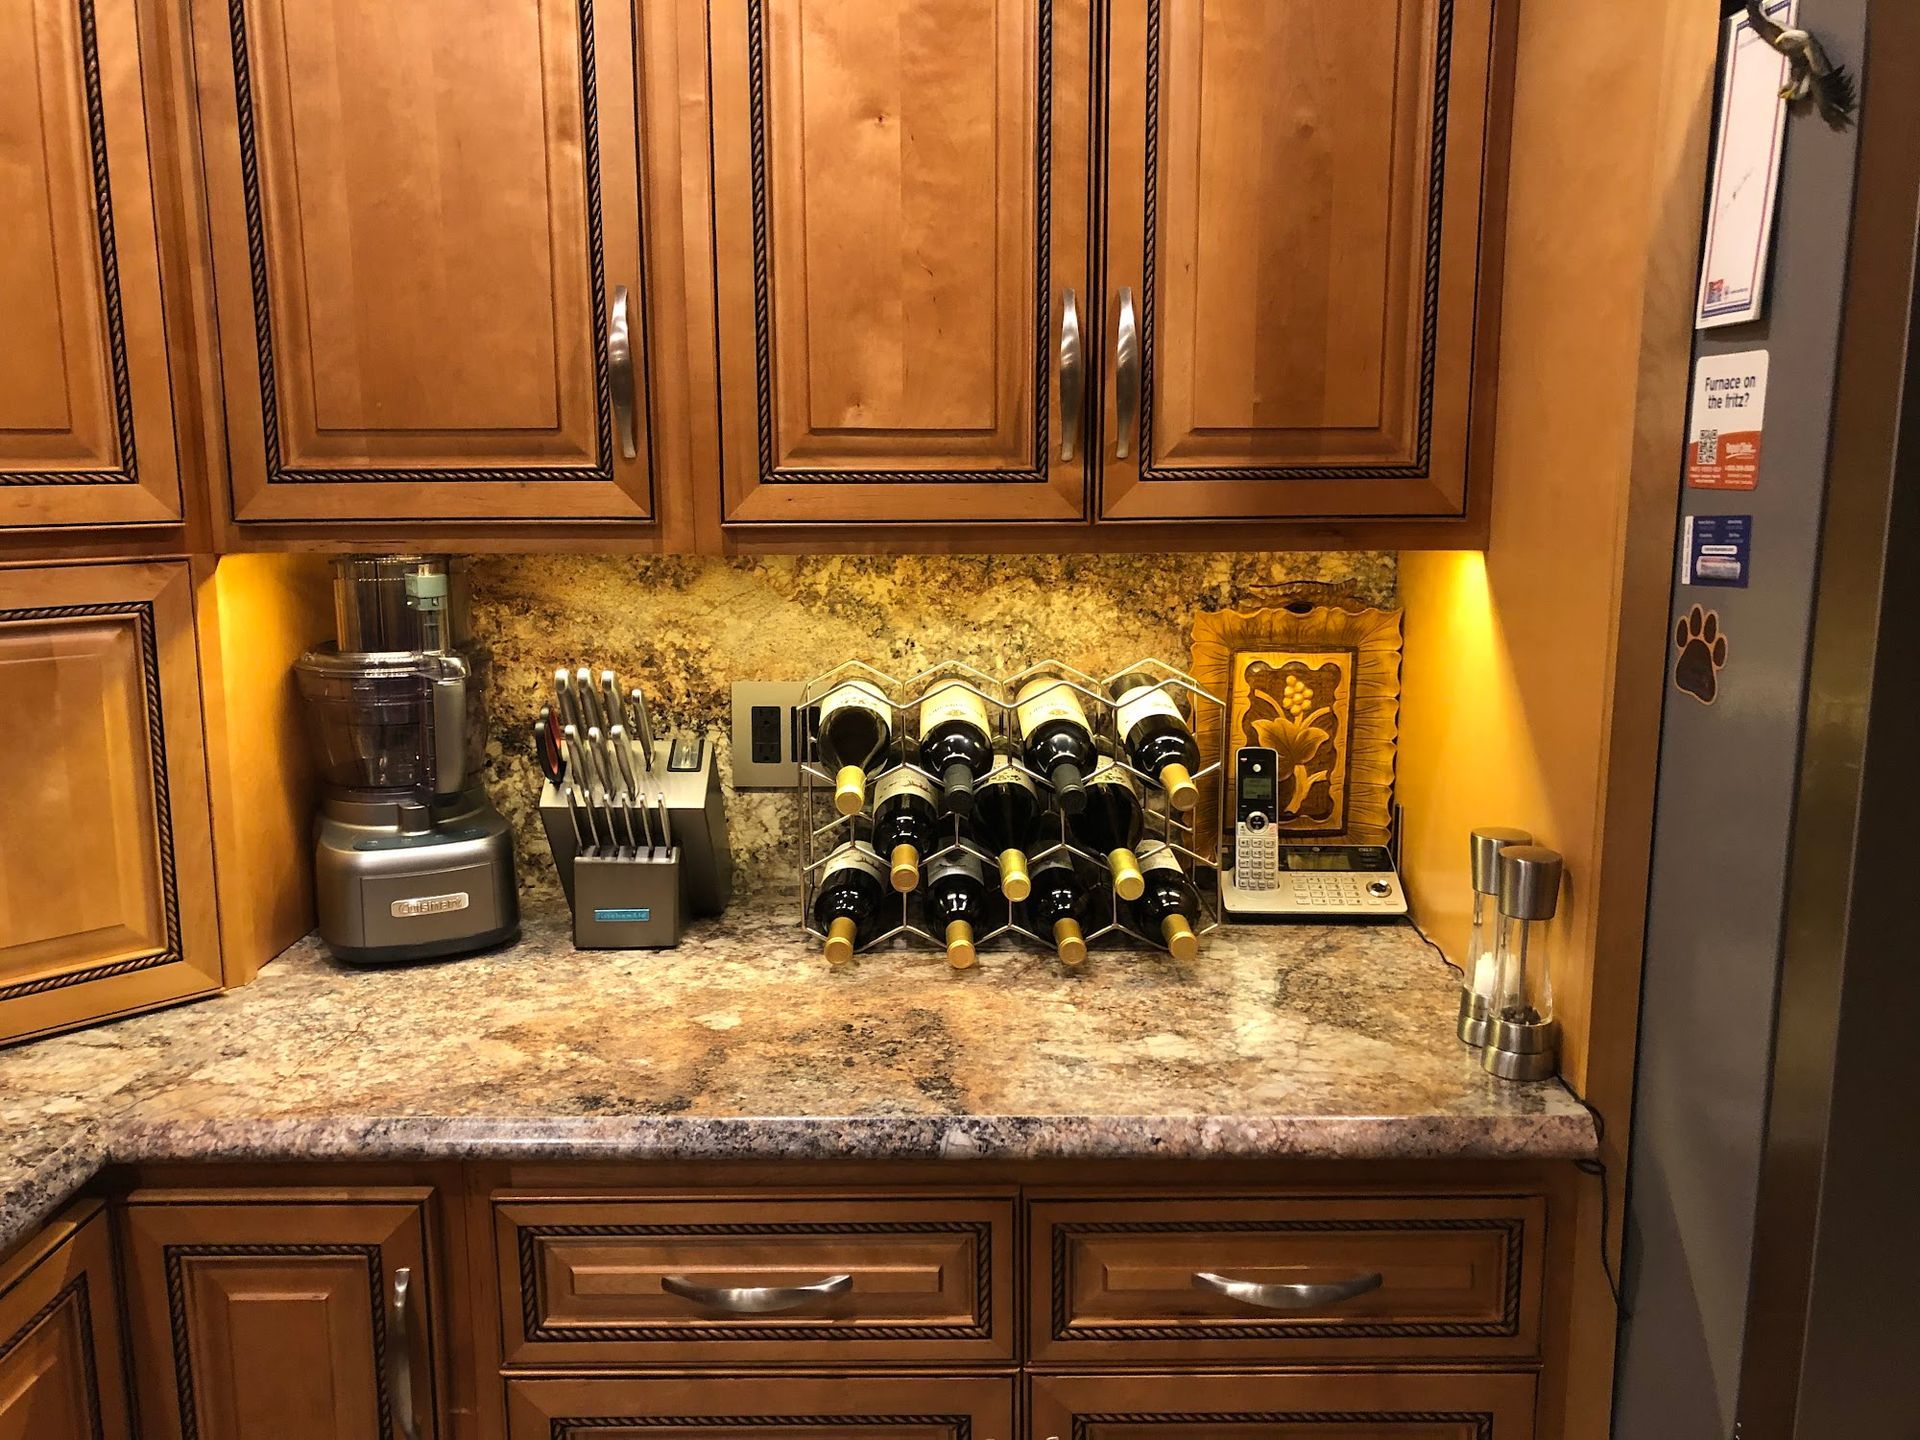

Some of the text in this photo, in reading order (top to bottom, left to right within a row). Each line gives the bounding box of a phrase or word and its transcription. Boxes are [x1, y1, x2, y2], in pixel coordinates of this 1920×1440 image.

[1705, 376, 1755, 391] Furnace on
[1708, 391, 1750, 409] the fritz?
